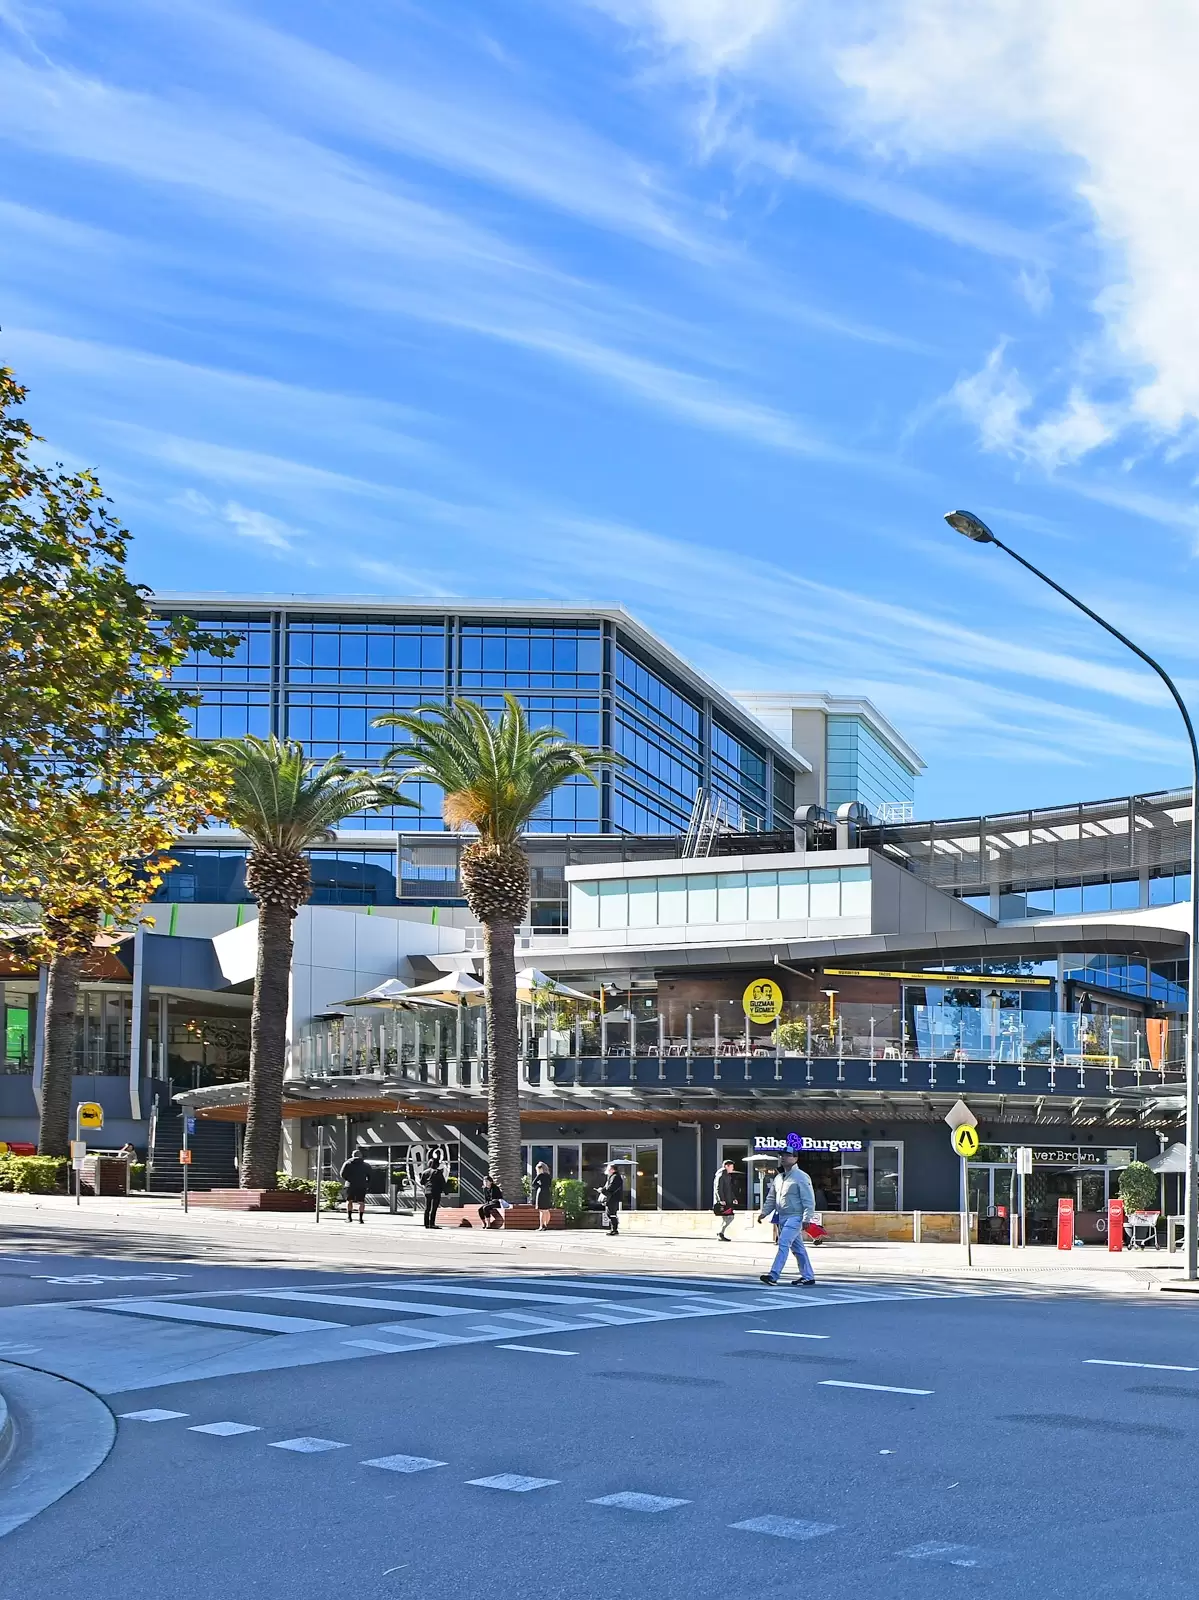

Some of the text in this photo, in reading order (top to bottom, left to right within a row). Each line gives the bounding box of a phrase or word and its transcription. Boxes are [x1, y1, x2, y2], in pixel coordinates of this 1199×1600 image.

[754, 1132, 862, 1152] Ribs & Burgers
[1013, 1149, 1100, 1163] verBrown.
